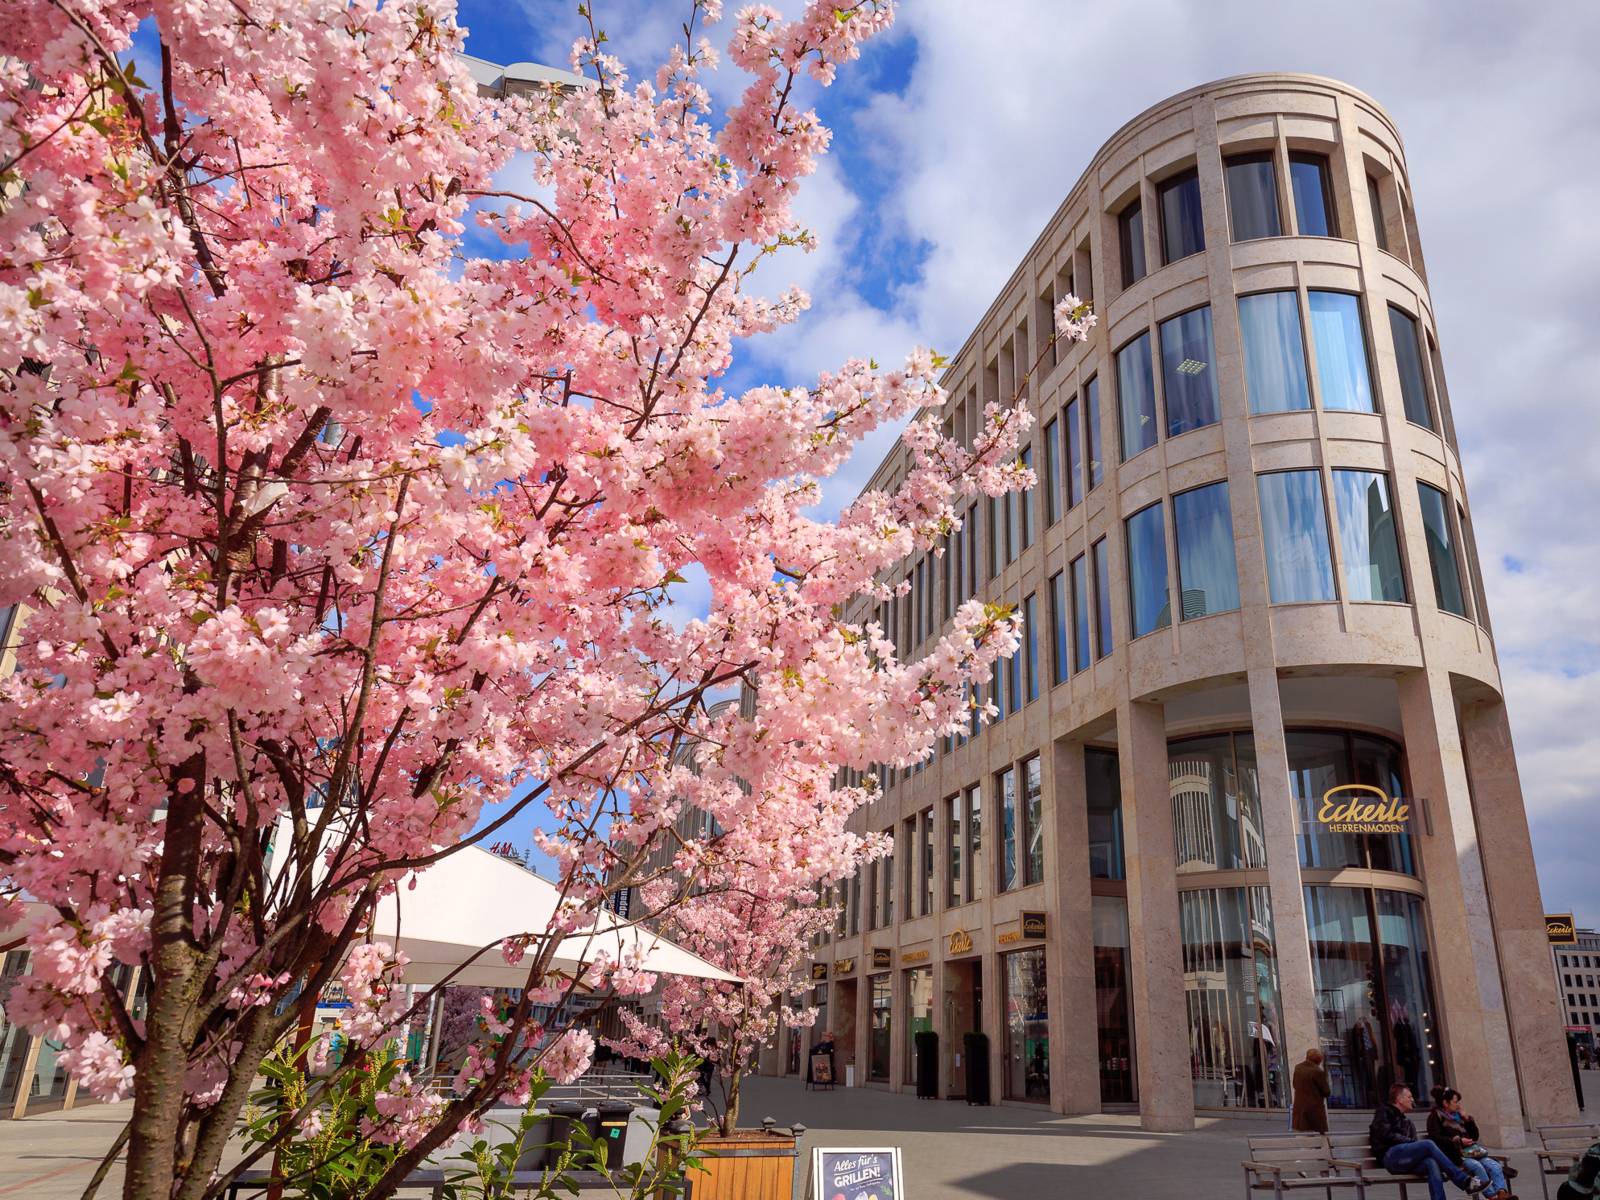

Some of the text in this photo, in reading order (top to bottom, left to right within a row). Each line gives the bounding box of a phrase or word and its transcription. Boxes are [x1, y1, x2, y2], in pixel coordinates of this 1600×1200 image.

[1318, 784, 1409, 823] Eckerle
[1329, 823, 1404, 833] HERRENMODEN
[1546, 922, 1573, 934] Eckerle
[834, 1159, 857, 1172] Alles
[834, 1166, 881, 1188] GRILLEN!
